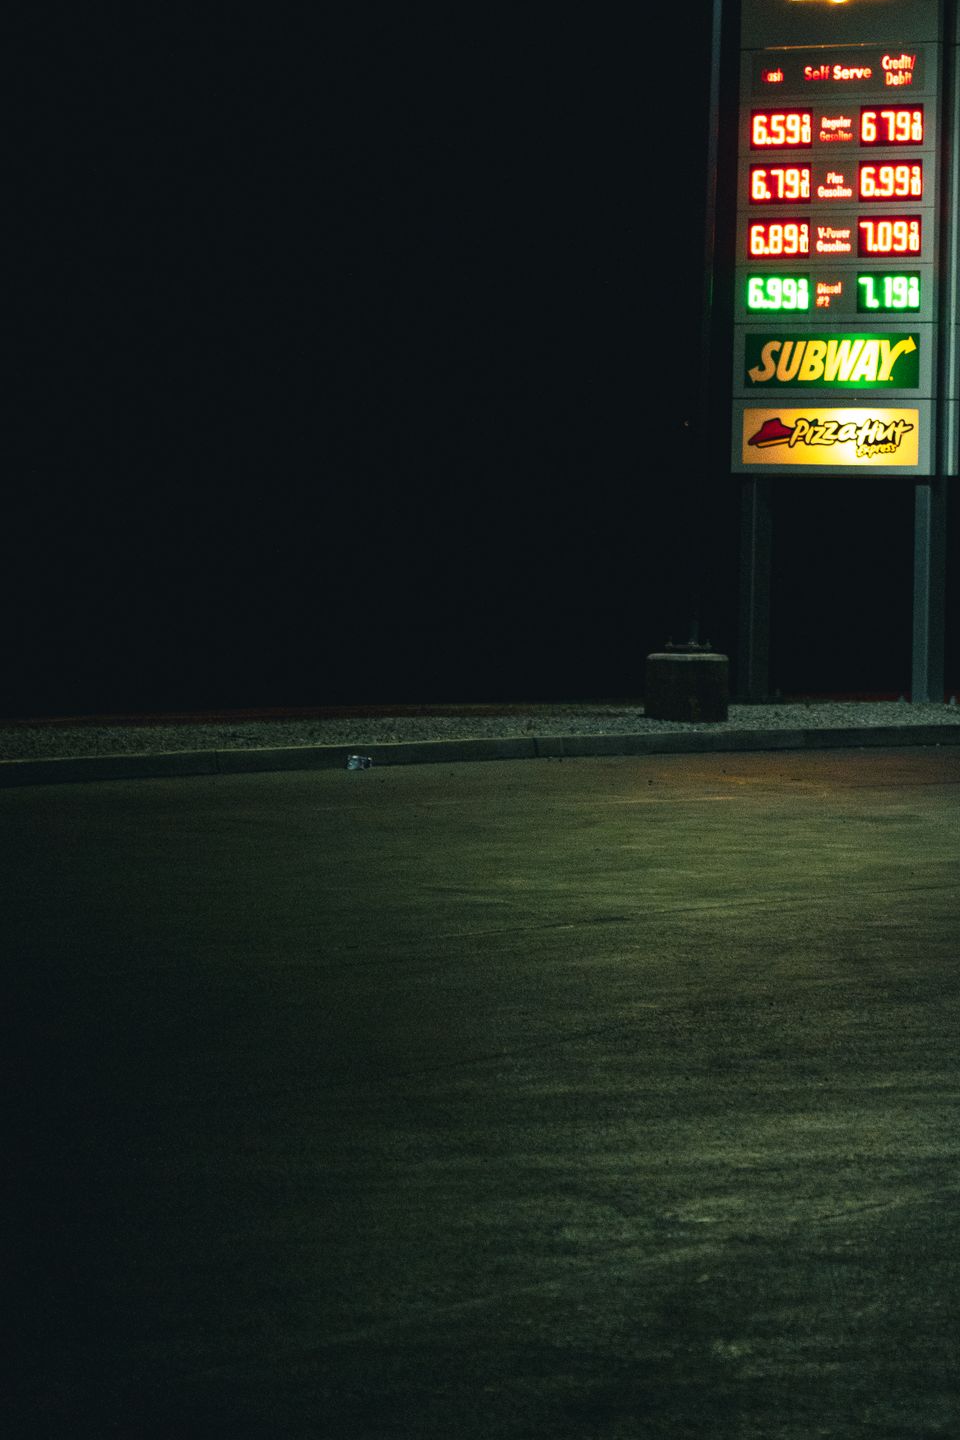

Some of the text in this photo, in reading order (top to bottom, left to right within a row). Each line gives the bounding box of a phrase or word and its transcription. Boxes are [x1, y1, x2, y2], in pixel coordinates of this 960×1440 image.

[804, 64, 872, 80] Self Serve
[885, 71, 912, 86] Debit
[822, 116, 851, 130] Regular
[820, 130, 853, 142] Gasoline
[827, 172, 843, 184] Plus
[818, 186, 852, 197] Gasoline
[817, 227, 850, 239] V-Power
[816, 240, 851, 252] Gasoline
[817, 282, 842, 294] Diesel
[816, 297, 830, 308] #2
[748, 336, 916, 382] SUBWAY
[790, 418, 914, 447] Pizza Hut
